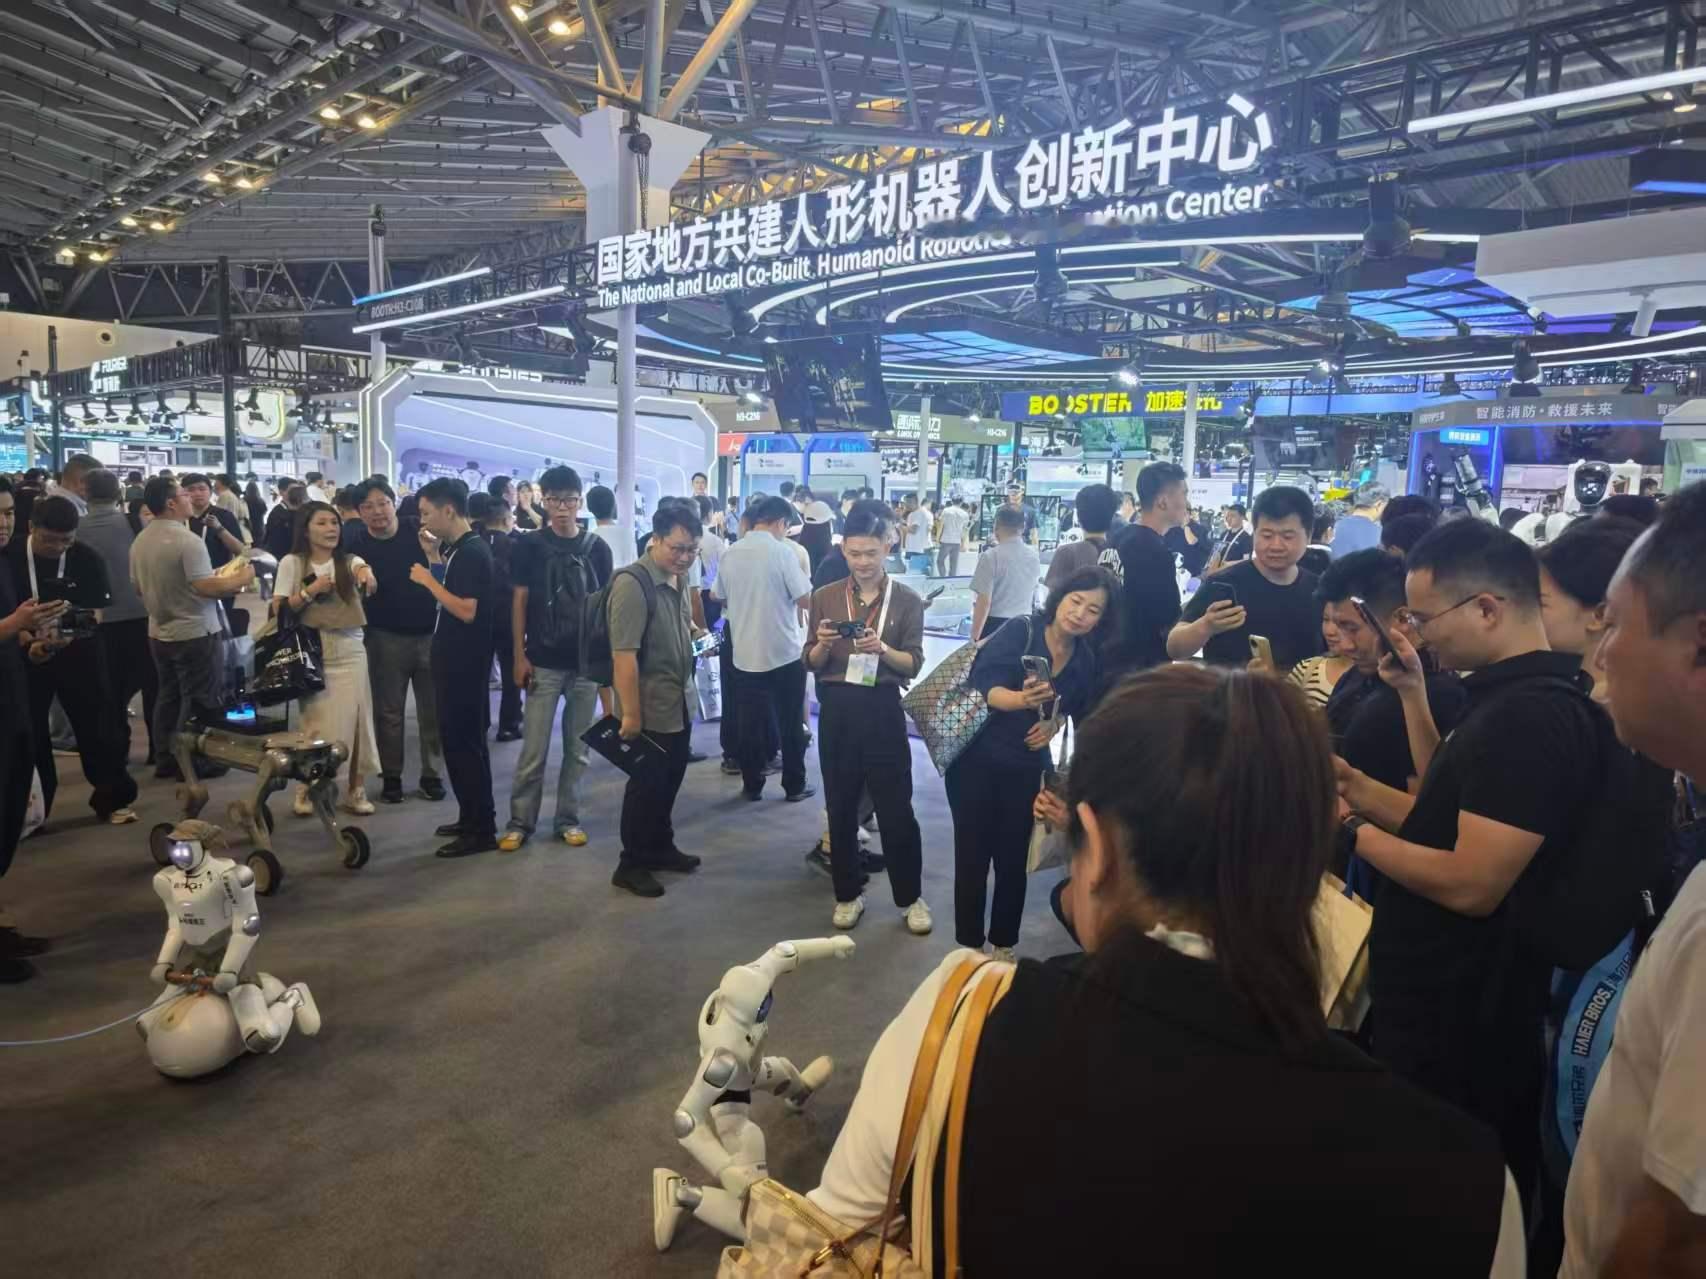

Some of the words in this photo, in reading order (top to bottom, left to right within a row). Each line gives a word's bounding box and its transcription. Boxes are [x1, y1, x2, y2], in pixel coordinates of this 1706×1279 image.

[597, 93, 1273, 284] 国家地方共建人形机器人创新中心
[597, 288, 620, 308] The
[621, 277, 674, 304] National
[676, 272, 703, 298] and
[706, 265, 743, 292] Local
[746, 254, 811, 287] Co-Built
[817, 235, 916, 276] Humanoid
[1166, 182, 1268, 222] Center
[1573, 1018, 1595, 1056] HAIER
